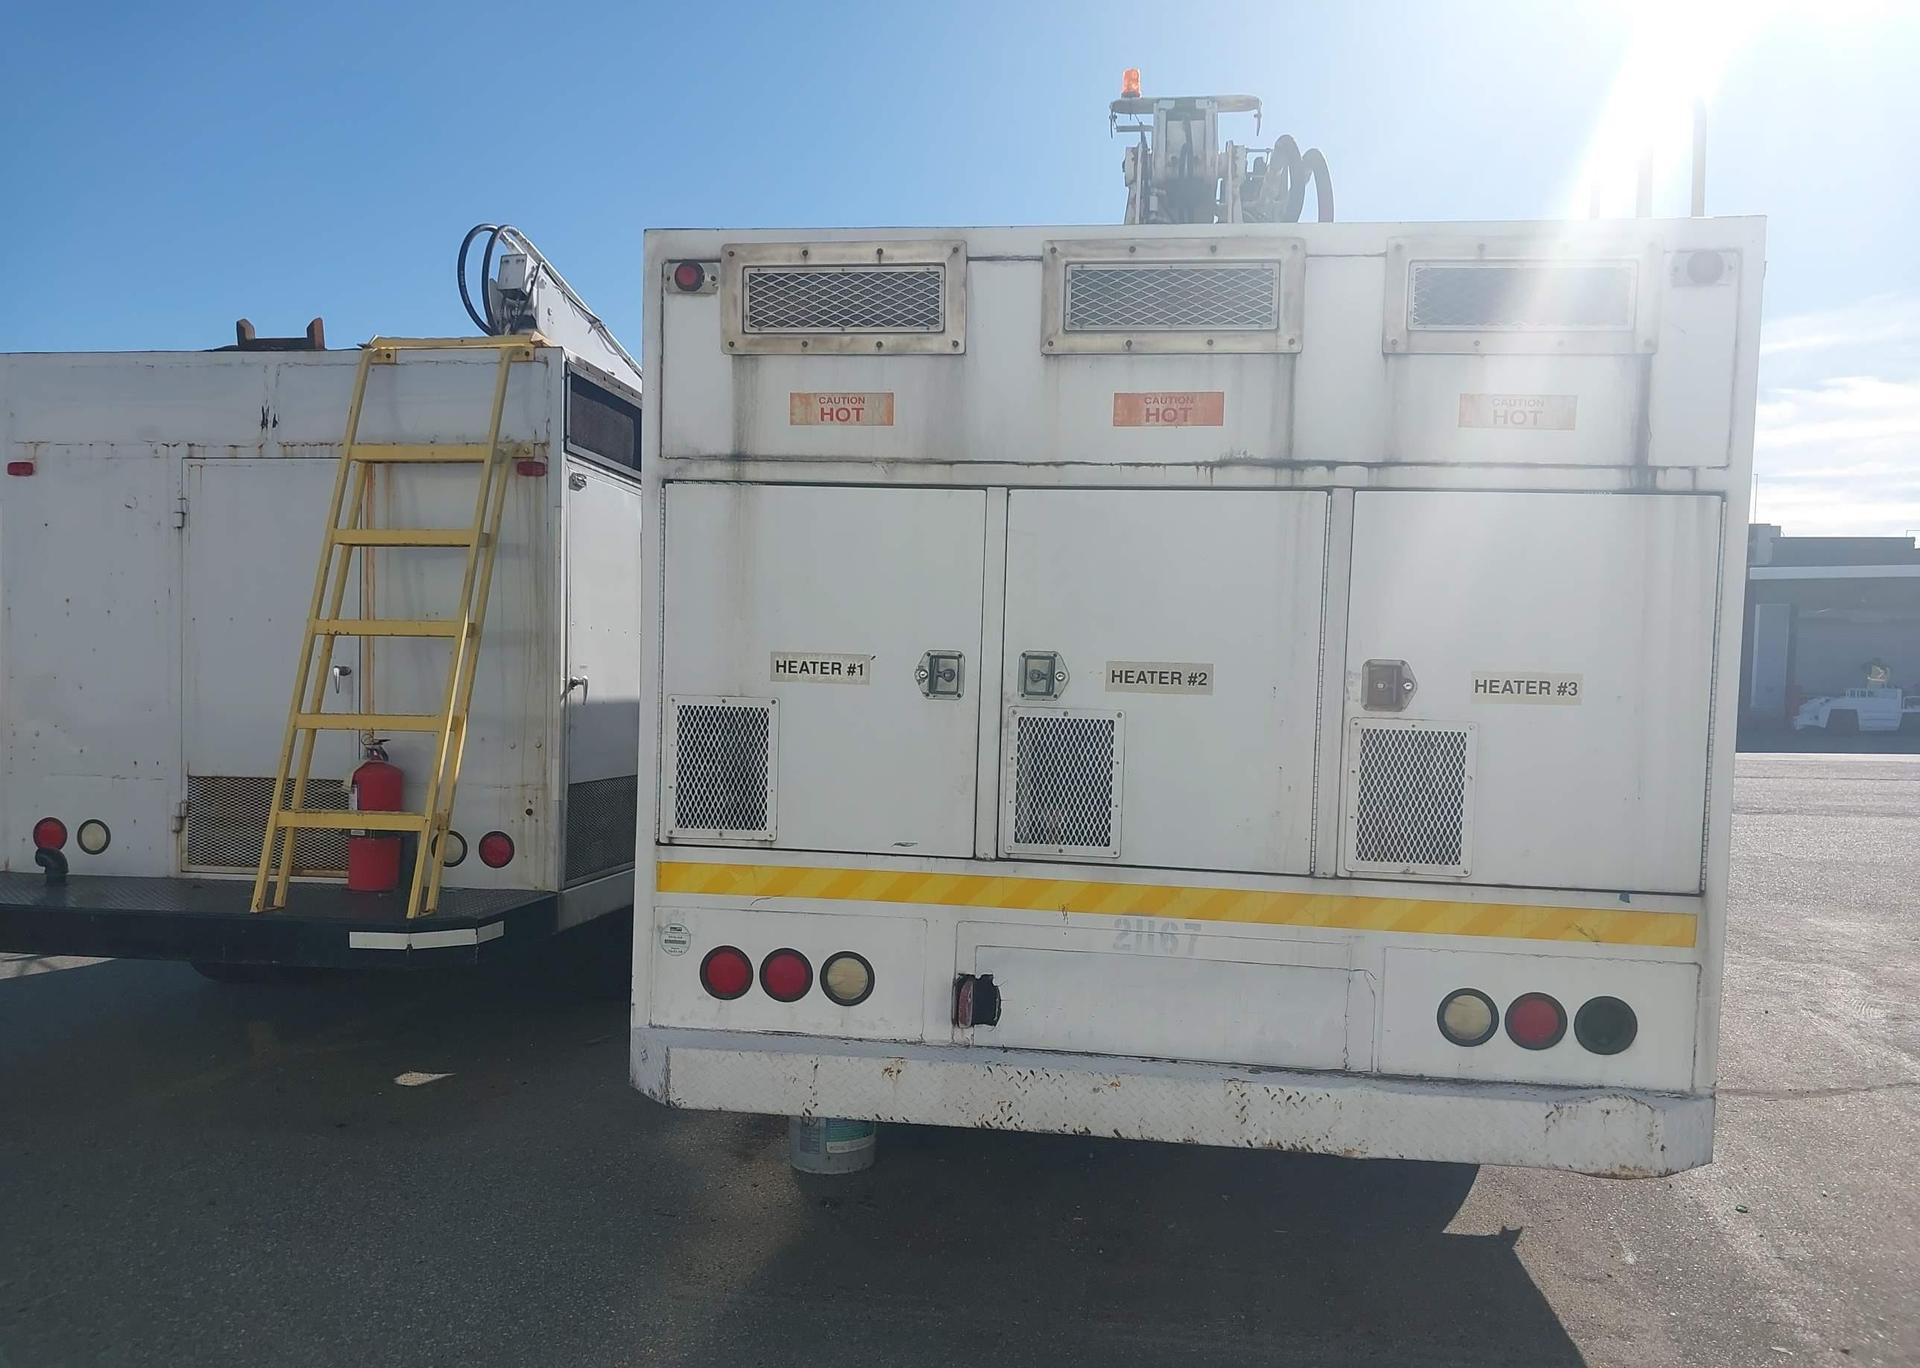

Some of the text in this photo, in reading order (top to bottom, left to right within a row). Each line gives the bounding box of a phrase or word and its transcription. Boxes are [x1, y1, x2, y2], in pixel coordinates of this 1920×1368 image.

[818, 396, 865, 405] CAUTION
[1144, 396, 1194, 405] CAUTION
[1492, 398, 1544, 408] CAUTION
[820, 407, 865, 422] HOT
[1145, 407, 1193, 423] HOT
[1492, 409, 1544, 426] HOT
[775, 660, 864, 676] HEATER #1
[1111, 669, 1208, 686] HEATER #2
[1474, 679, 1578, 697] HEATER #3
